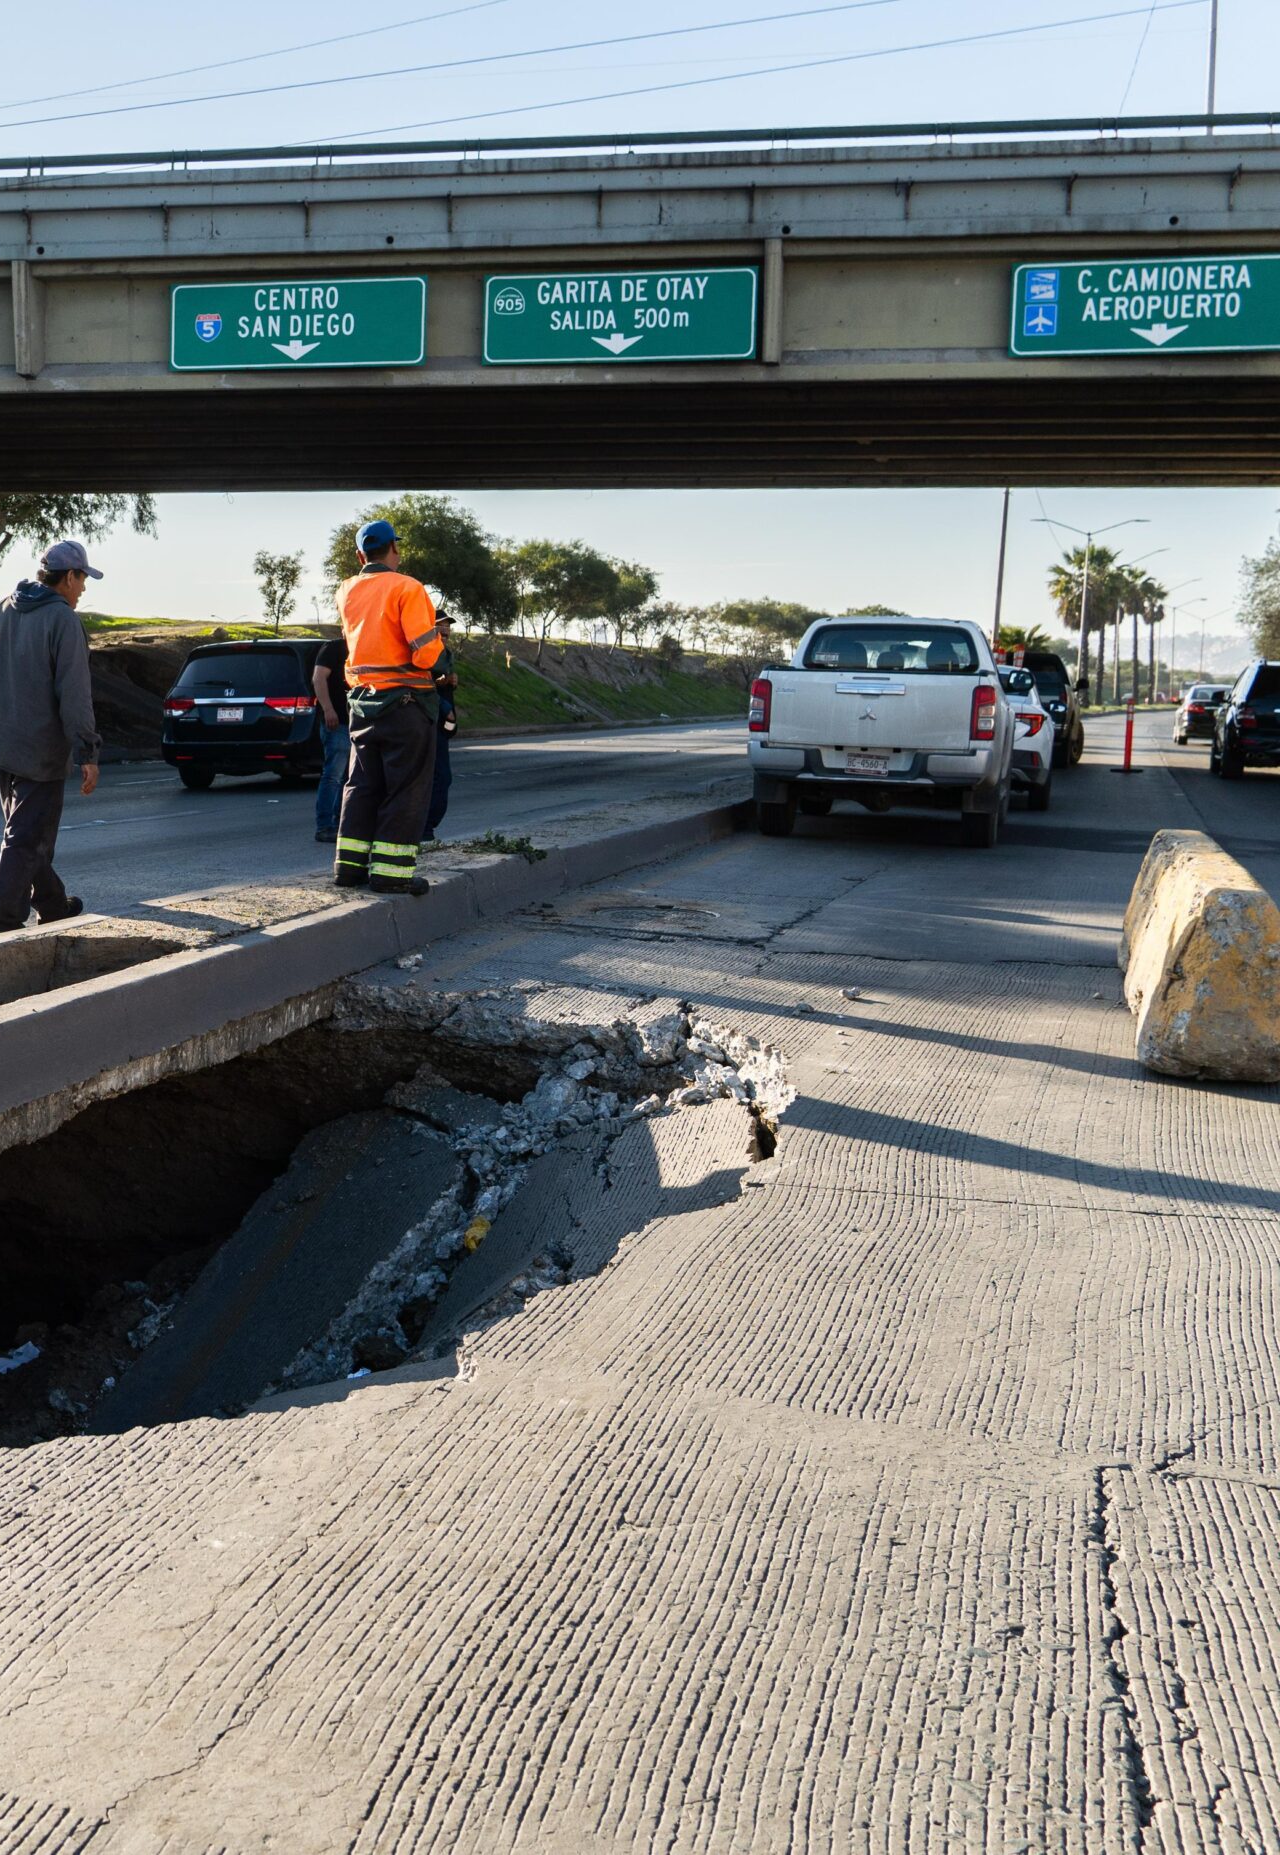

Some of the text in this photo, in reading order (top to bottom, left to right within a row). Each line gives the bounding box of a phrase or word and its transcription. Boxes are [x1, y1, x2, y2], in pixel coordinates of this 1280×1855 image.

[538, 277, 708, 304] GARITA DE OTAY
[1077, 264, 1251, 293] C. CAMIONERA
[255, 287, 338, 311] CENTRO
[496, 298, 523, 311] 905
[1081, 292, 1241, 321] AEROPUERTO
[202, 321, 215, 338] 5
[237, 313, 354, 338] SAN DIEGO
[550, 309, 616, 330] SALIDA
